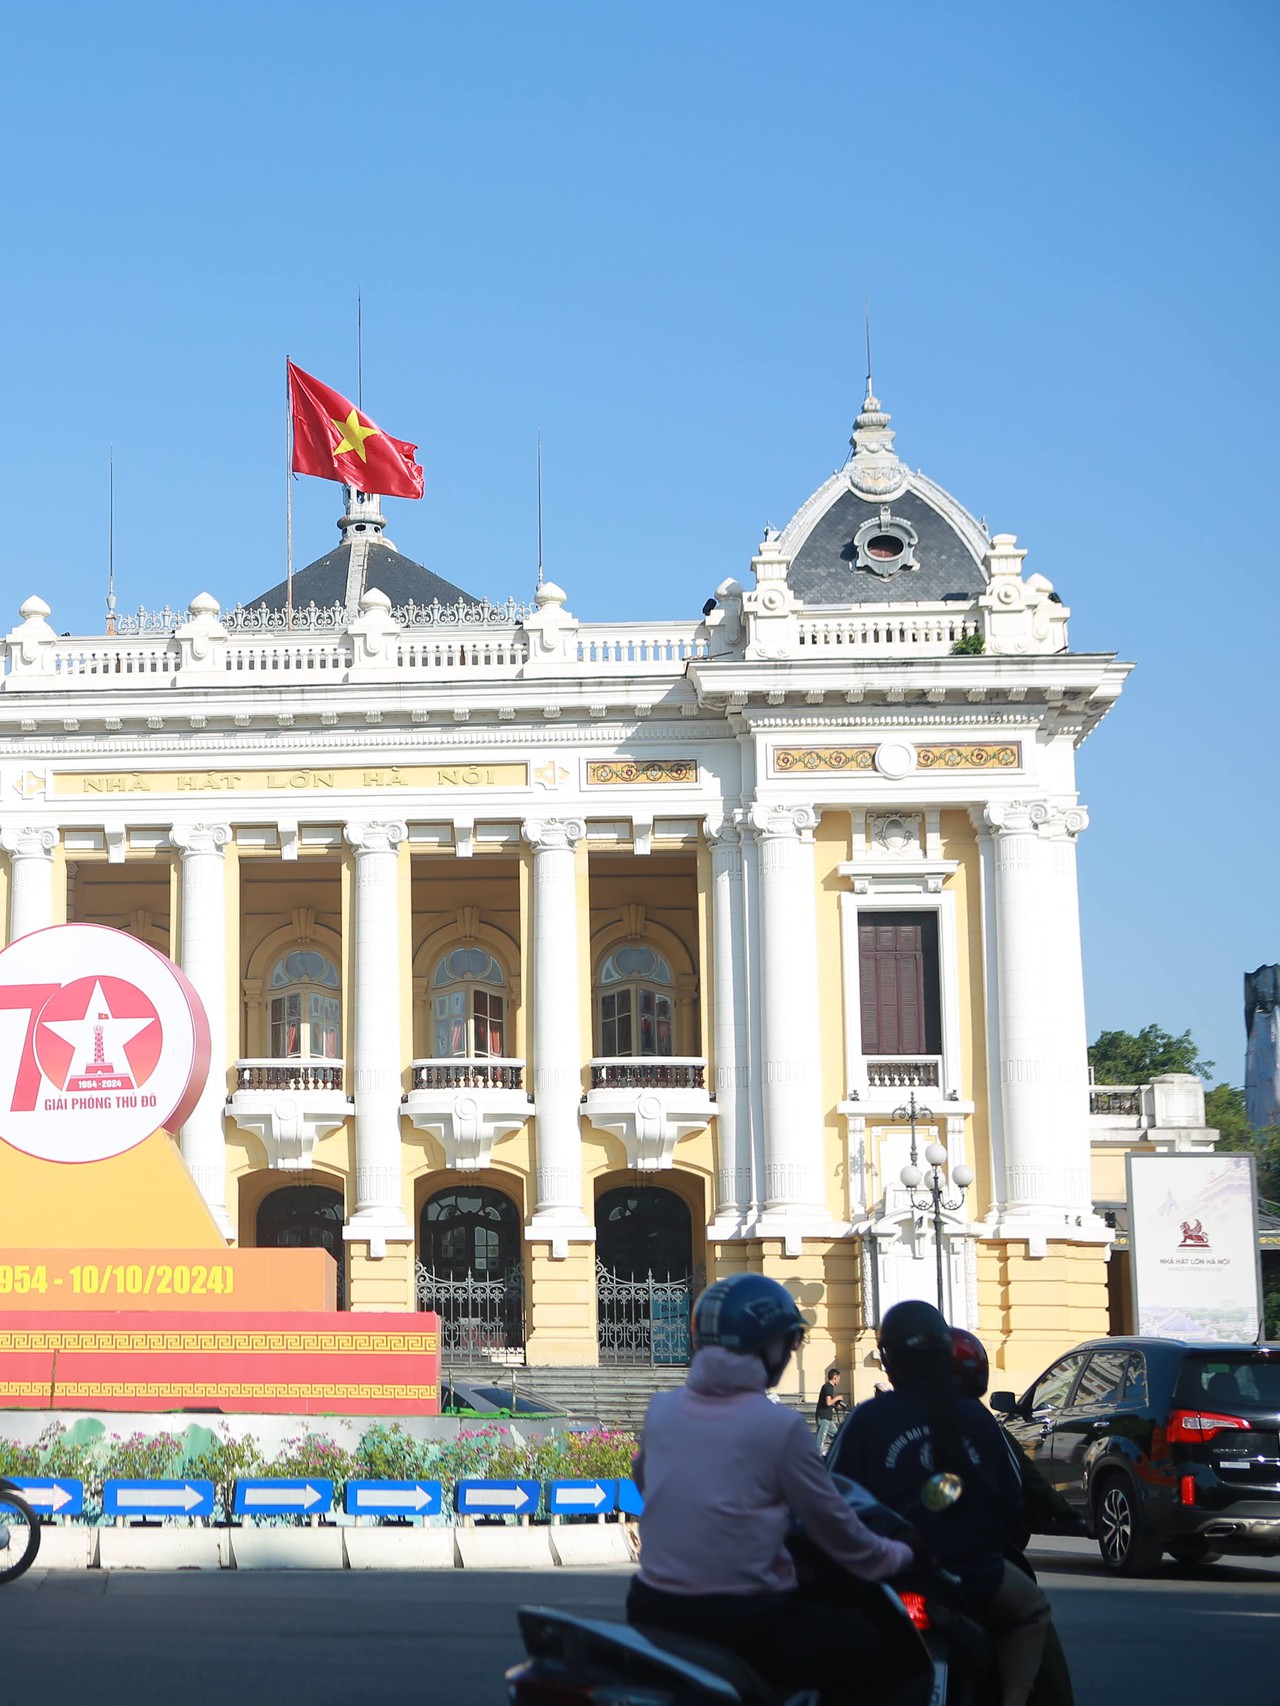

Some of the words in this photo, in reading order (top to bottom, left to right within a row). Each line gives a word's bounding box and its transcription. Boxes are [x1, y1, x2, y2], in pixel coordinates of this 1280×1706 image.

[83, 771, 150, 792] NHÀ
[177, 769, 241, 791] HÁT
[363, 766, 409, 787] HÀ
[44, 1095, 68, 1111] GIẢI
[71, 1094, 111, 1110] PHÓNG
[115, 1091, 137, 1108] THỦ
[141, 1092, 157, 1107] ĐÔ
[54, 1277, 64, 1286] -
